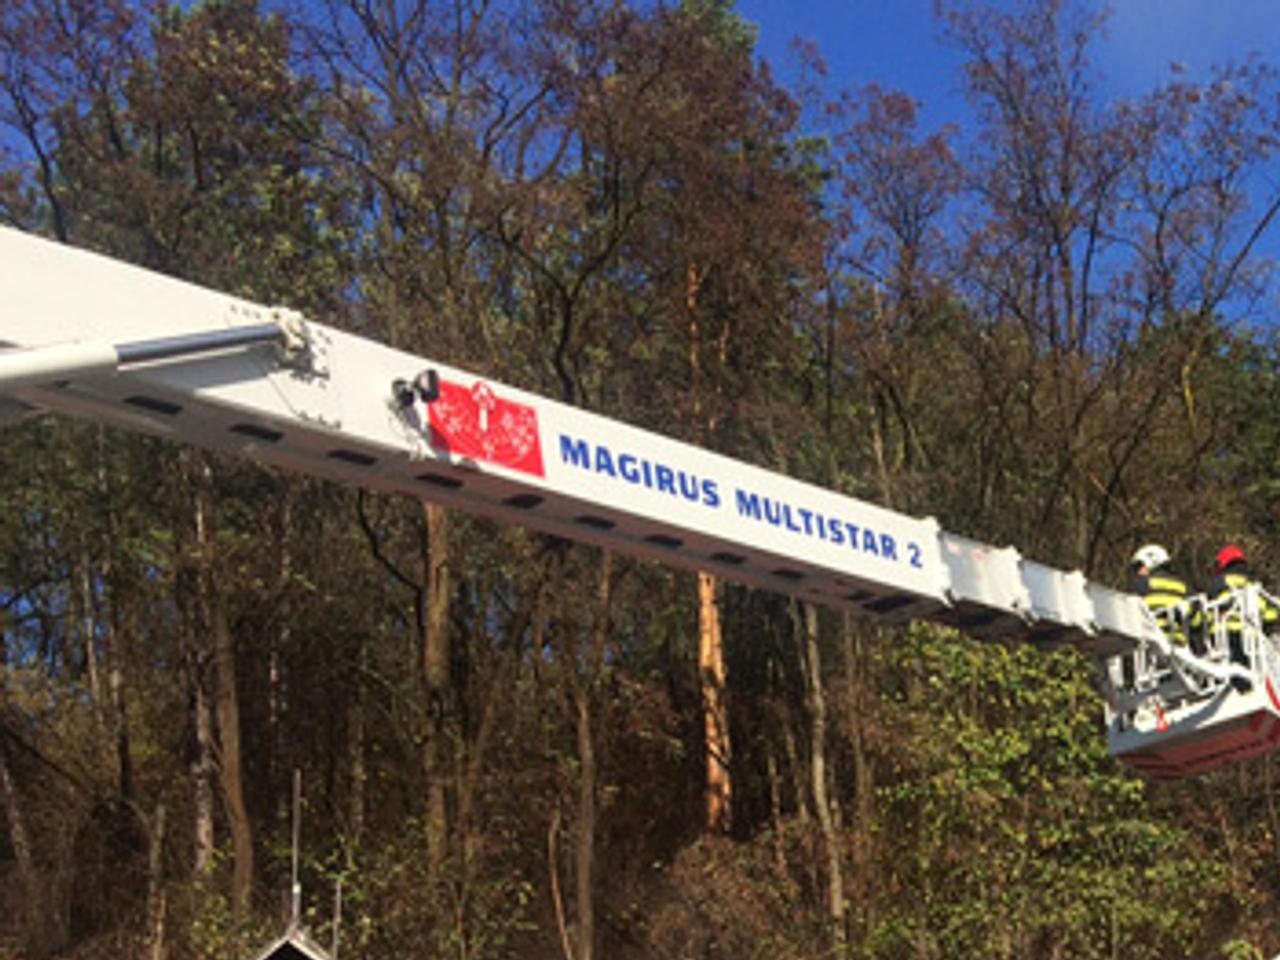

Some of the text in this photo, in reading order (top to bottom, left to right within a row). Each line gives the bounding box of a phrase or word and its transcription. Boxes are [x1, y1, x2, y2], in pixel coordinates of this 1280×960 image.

[559, 434, 924, 568] MAGIRUS MULTISTAR 2
